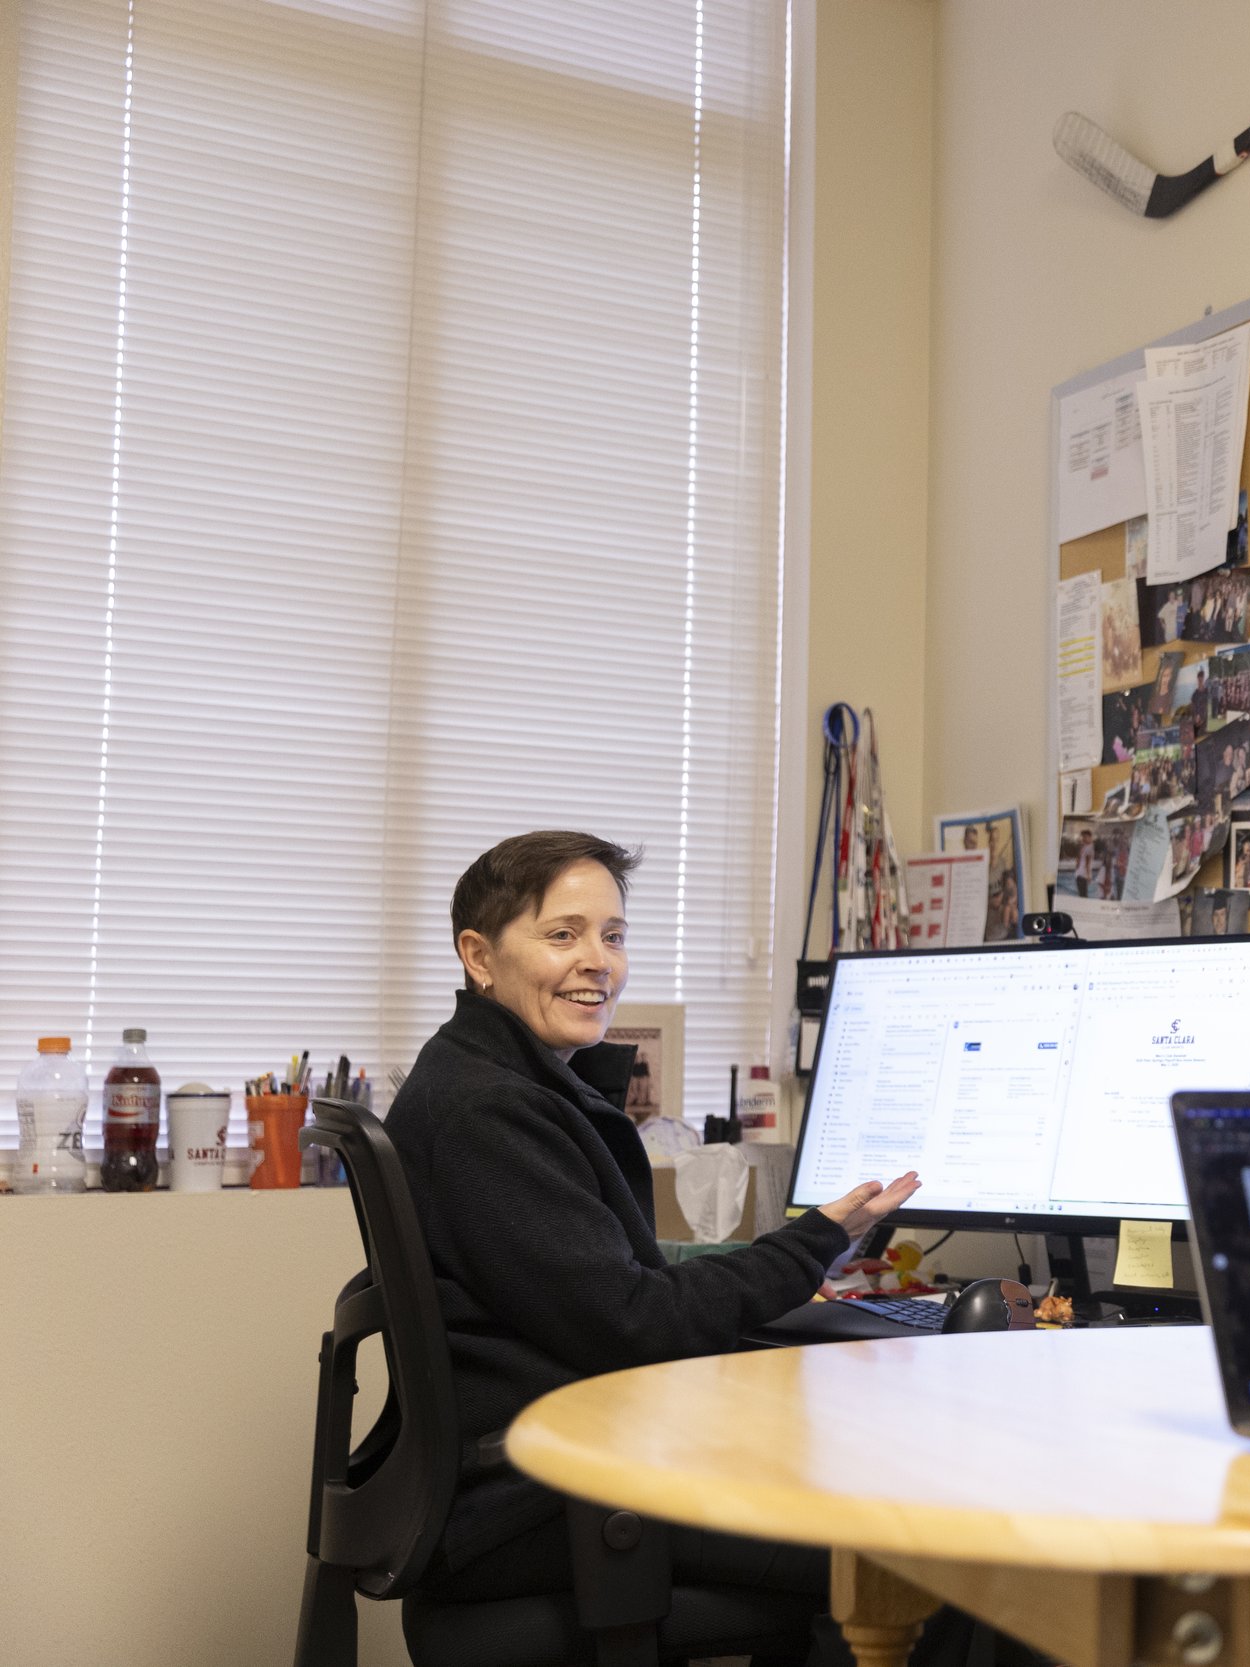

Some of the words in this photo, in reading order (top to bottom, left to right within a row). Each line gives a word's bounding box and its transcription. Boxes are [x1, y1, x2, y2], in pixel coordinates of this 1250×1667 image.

[1152, 1036, 1172, 1045] SANTA
[1174, 1035, 1195, 1045] CLARA
[186, 1148, 220, 1160] SANTA
